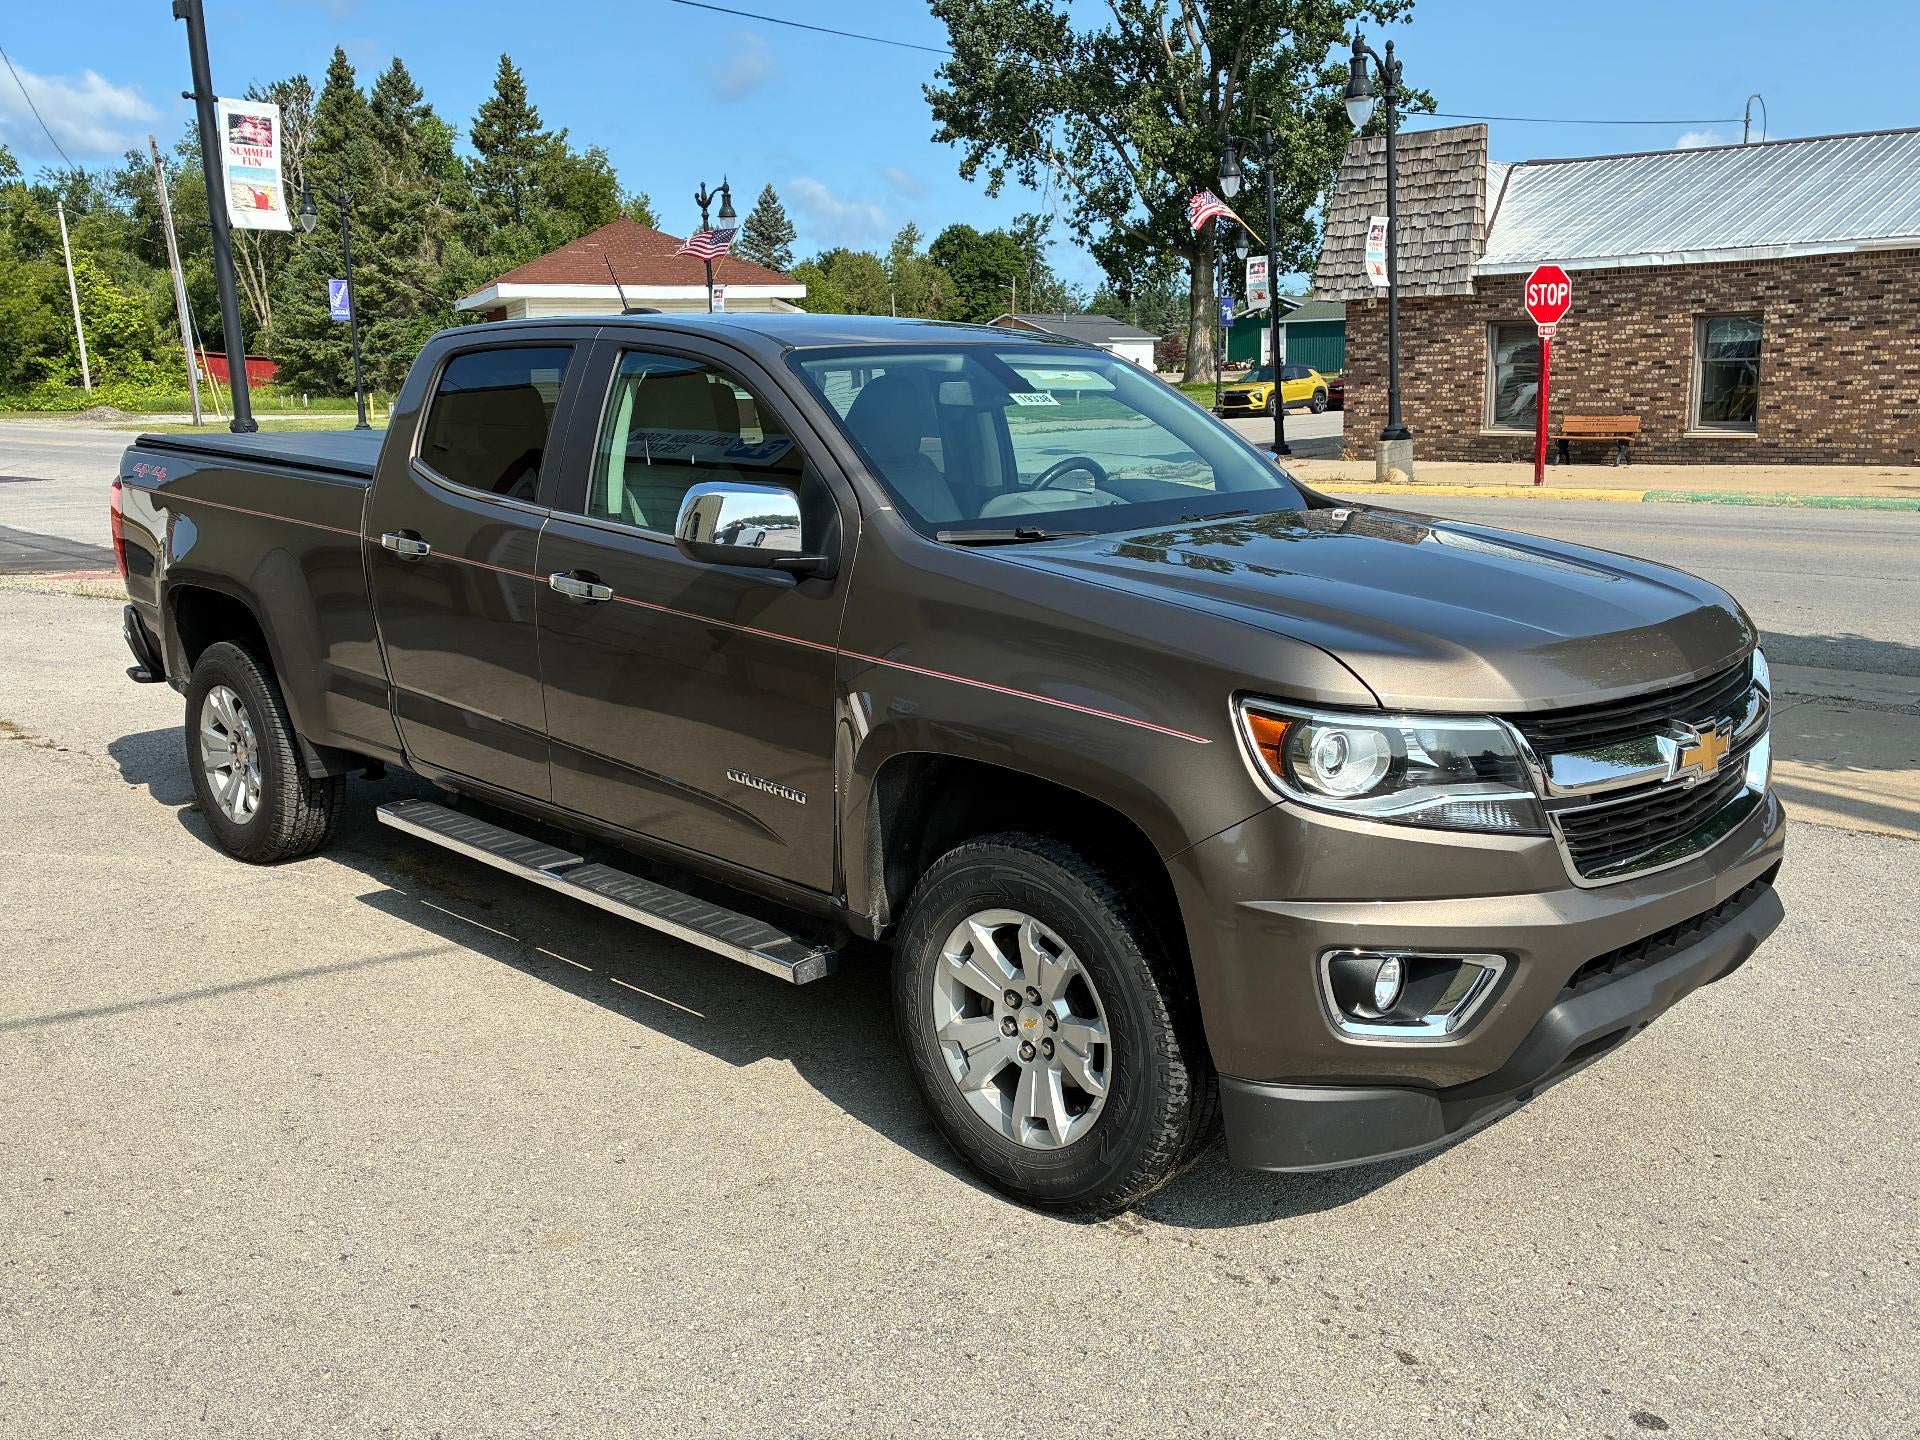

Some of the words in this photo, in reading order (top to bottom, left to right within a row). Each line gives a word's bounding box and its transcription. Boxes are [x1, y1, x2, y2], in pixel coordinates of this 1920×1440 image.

[229, 146, 273, 159] SUMMER
[242, 156, 262, 167] FUN
[1528, 283, 1568, 306] STOP
[726, 768, 807, 805] COLORADO
